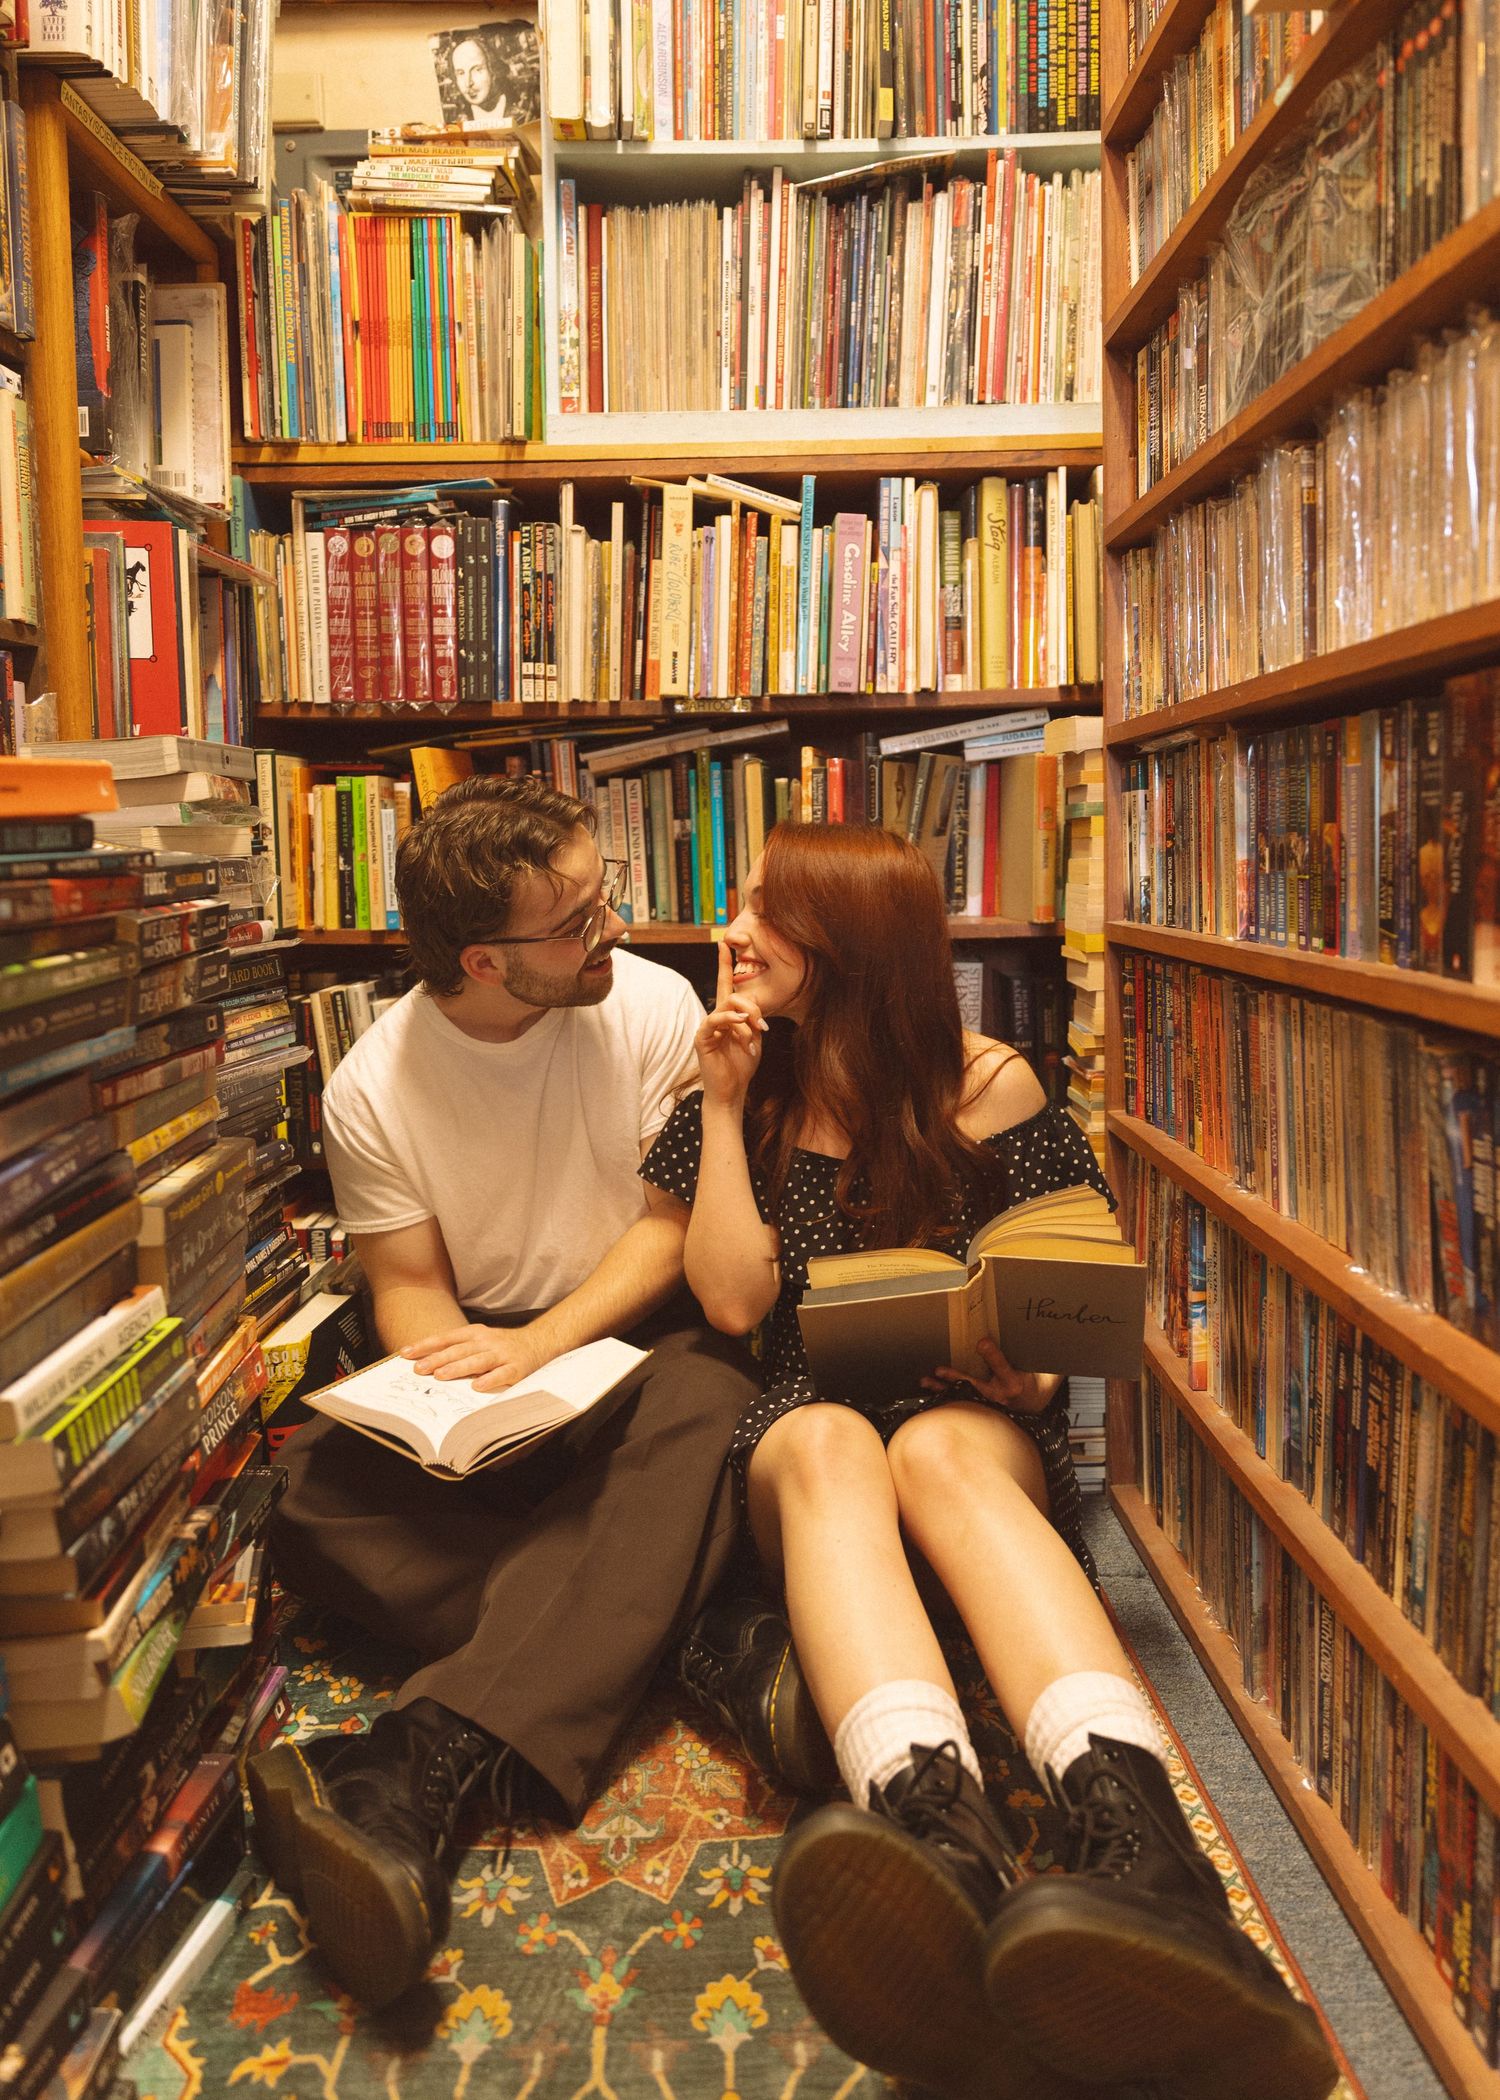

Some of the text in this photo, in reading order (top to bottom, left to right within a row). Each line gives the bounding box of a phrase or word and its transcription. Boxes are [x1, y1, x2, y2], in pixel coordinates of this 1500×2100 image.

[882, 0, 891, 51] MAD NIGHT
[1019, 10, 1028, 95] BIG BOOK OF VICE
[1029, 2, 1038, 93] THE BIG BOOK BAD
[1049, 10, 1058, 99] BIG BOOK OF LOSERS
[1078, 6, 1087, 95] BIG BOOK OF THUGS
[1090, 13, 1099, 96] BOOK OF SCANDAL!
[656, 23, 667, 98] ALEX ROBINSON
[1038, 12, 1048, 107] BIG BOOK OF FREAKS
[1057, 11, 1066, 126] BOOK OF THE UNEXPLAINED
[1068, 4, 1077, 117] BOOK WILD WEST
[389, 145, 405, 154] THE
[431, 147, 467, 155] READER
[406, 166, 434, 174] POCKET
[561, 184, 575, 256] COMIC-CON
[281, 207, 296, 364] MASTERS OF COMIC BOOK ART
[590, 264, 601, 352] THE IRON GATE
[139, 288, 148, 377] ALIEN RACE
[777, 304, 786, 345] DISGUSTING
[1149, 370, 1157, 456] THE SPIRIT RING
[1199, 384, 1208, 446] FIREMASK
[535, 543, 544, 572] ABNER
[802, 485, 813, 572] OUTRAGEOUSLY POGO
[945, 518, 959, 582] BILL MAULDIN
[984, 512, 1007, 585] Steig ALBUM
[296, 570, 304, 592] STILL
[522, 547, 531, 585] ABNER
[546, 545, 555, 575] ABNER
[665, 543, 689, 625] RUBE GOLDBERG
[297, 597, 304, 607] IN
[311, 555, 322, 630] WEALTH OF PIGEONS
[650, 577, 662, 656] Half Naked Knight
[838, 543, 860, 652] Gasoline Alley
[298, 631, 307, 662] FAMILY
[458, 617, 466, 641] DOGS
[743, 601, 753, 671] SUNDAY PUNCH
[889, 620, 898, 666] GALLERY
[260, 758, 270, 811] Baxter Black
[341, 794, 350, 848] overwinter
[629, 782, 642, 884] NOT THAT KIND OF GIRL
[954, 853, 965, 894] ALBUM
[1041, 838, 1050, 870] THURBER
[252, 962, 274, 981] BOOK
[953, 969, 969, 1027] KING
[968, 967, 980, 1025] STEPHEN
[323, 1001, 337, 1041] DAY BY DAY
[1013, 980, 1023, 1034] BACHMAN
[264, 1350, 301, 1364] ASON
[337, 1346, 356, 1374] JASON
[201, 1381, 234, 1432] POISON
[201, 1401, 240, 1455] PRINCE
[1320, 1602, 1333, 1685] EARTH LORDS
